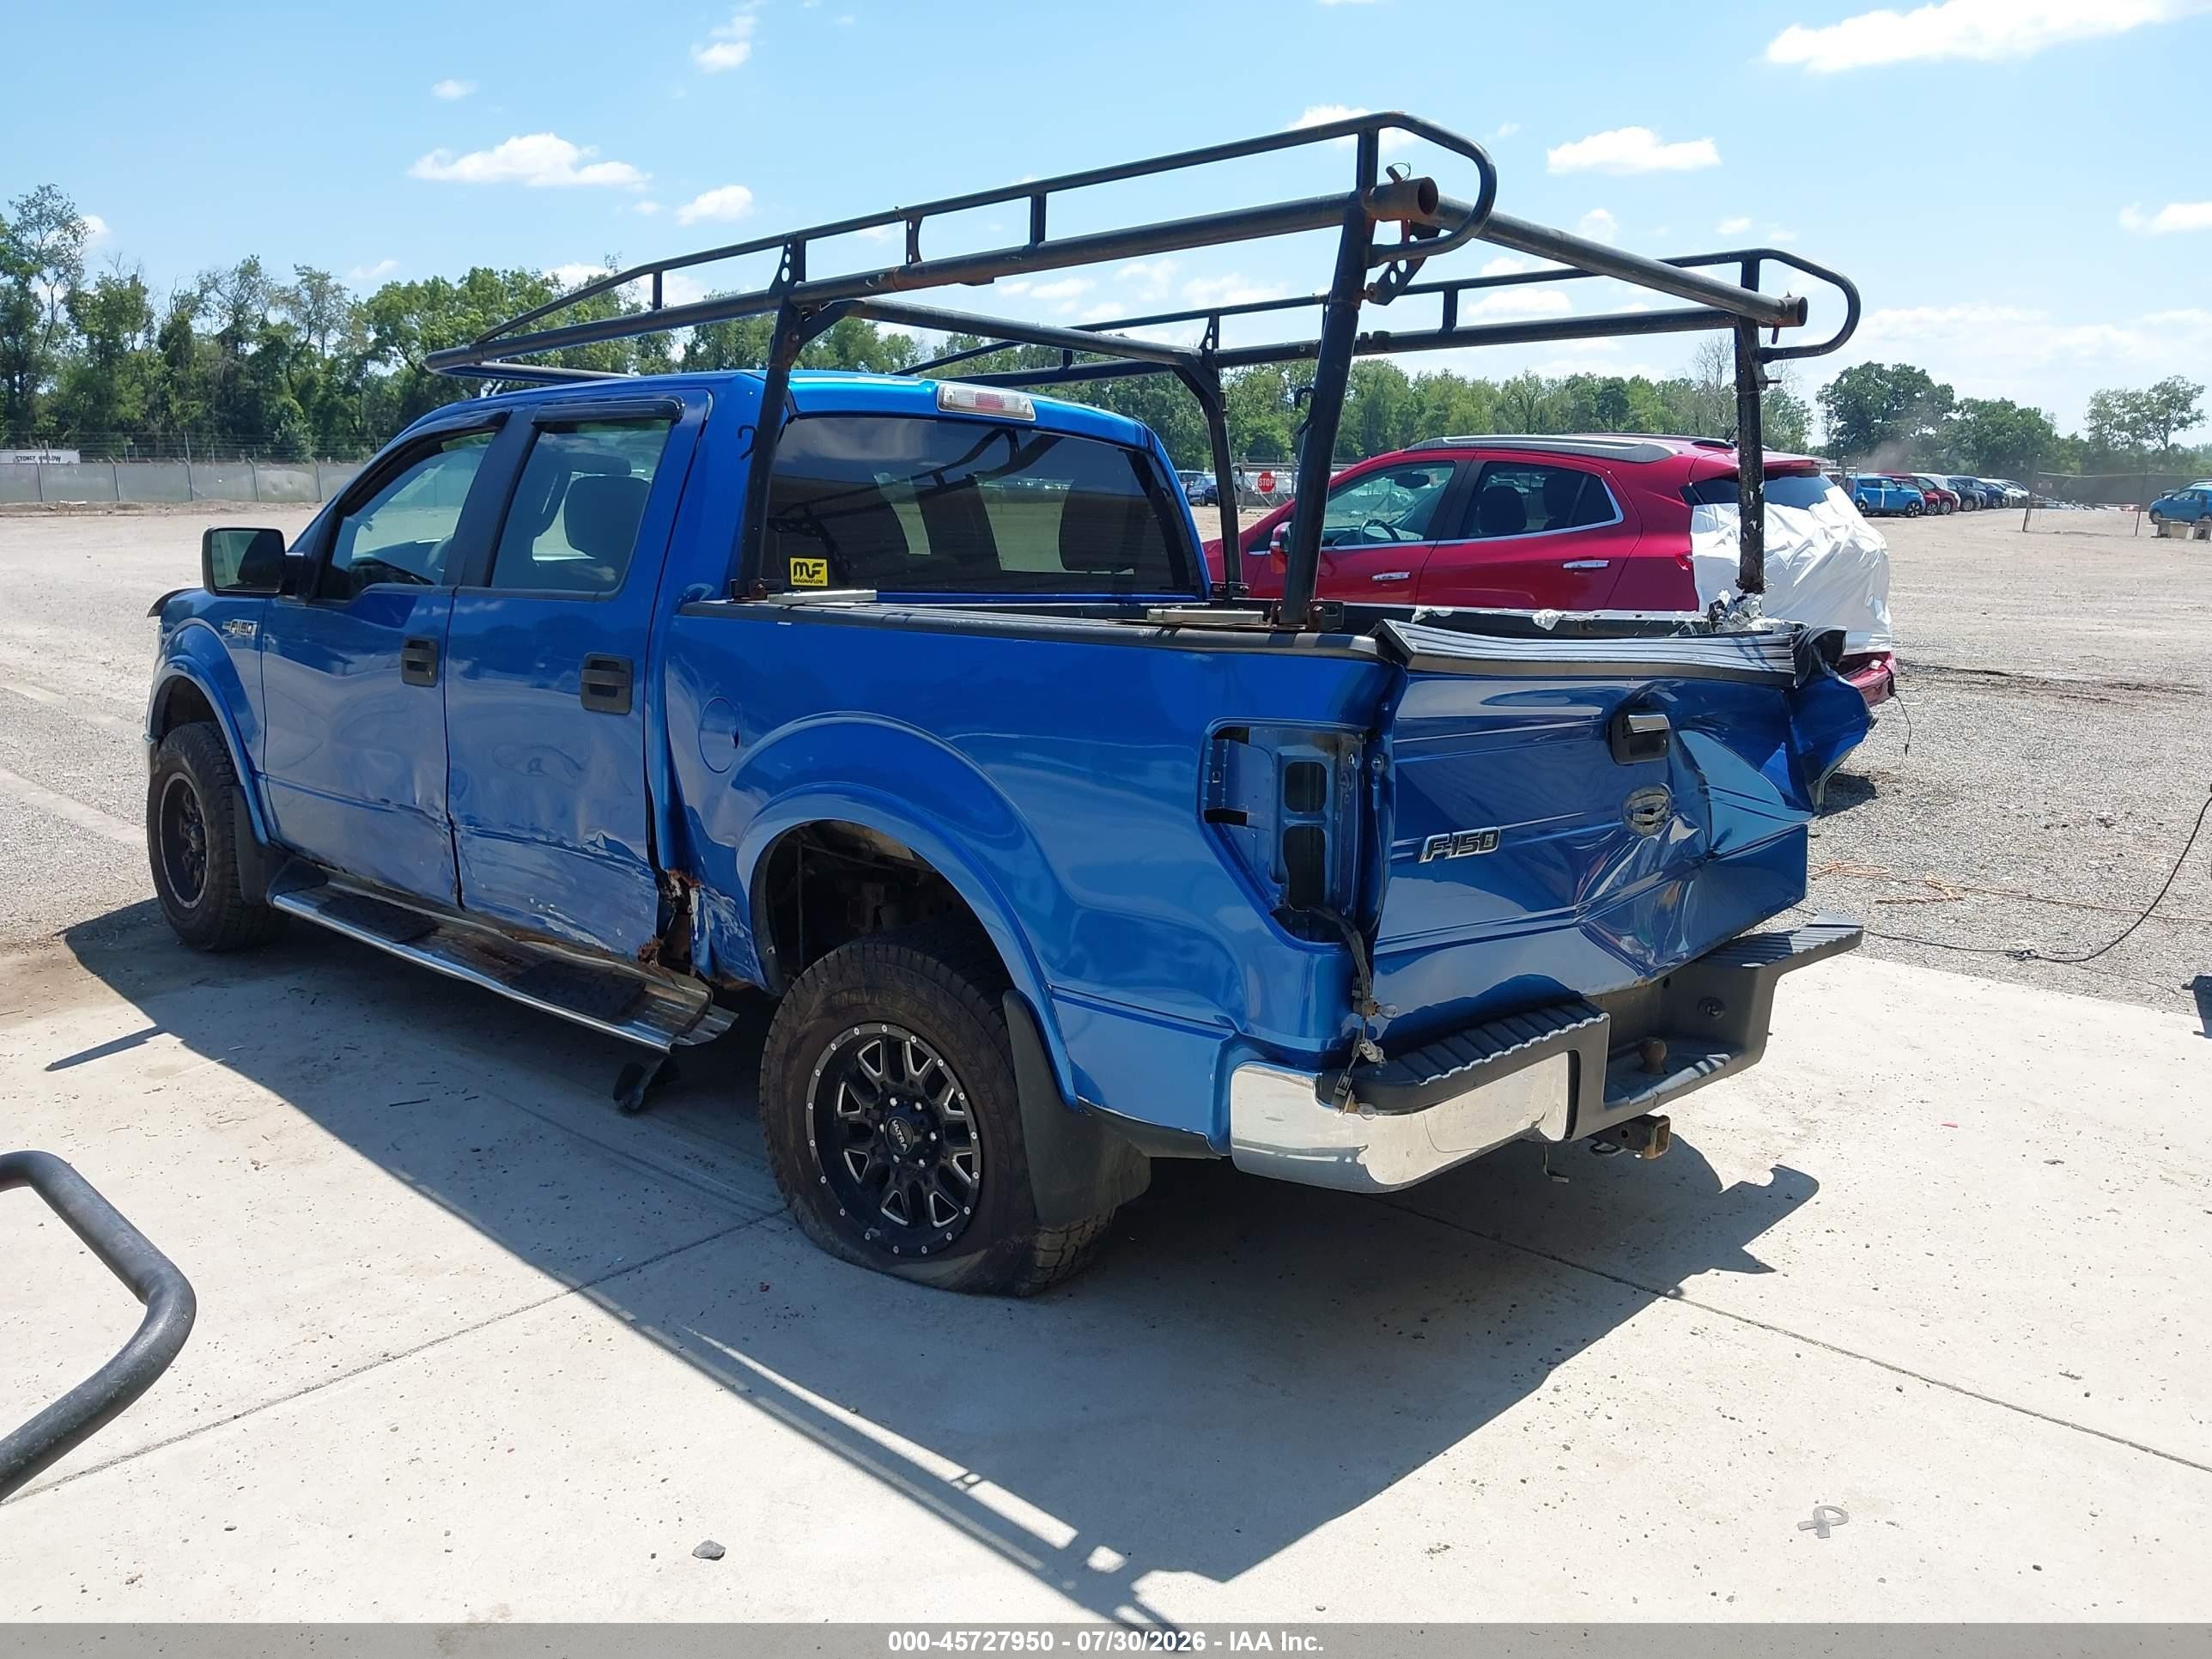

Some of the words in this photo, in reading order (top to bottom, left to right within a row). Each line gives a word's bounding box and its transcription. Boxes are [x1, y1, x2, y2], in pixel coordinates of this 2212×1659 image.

[1258, 477, 1275, 487] STOP
[1418, 827, 1501, 864] F-150
[891, 1120, 908, 1152] ULTRA
